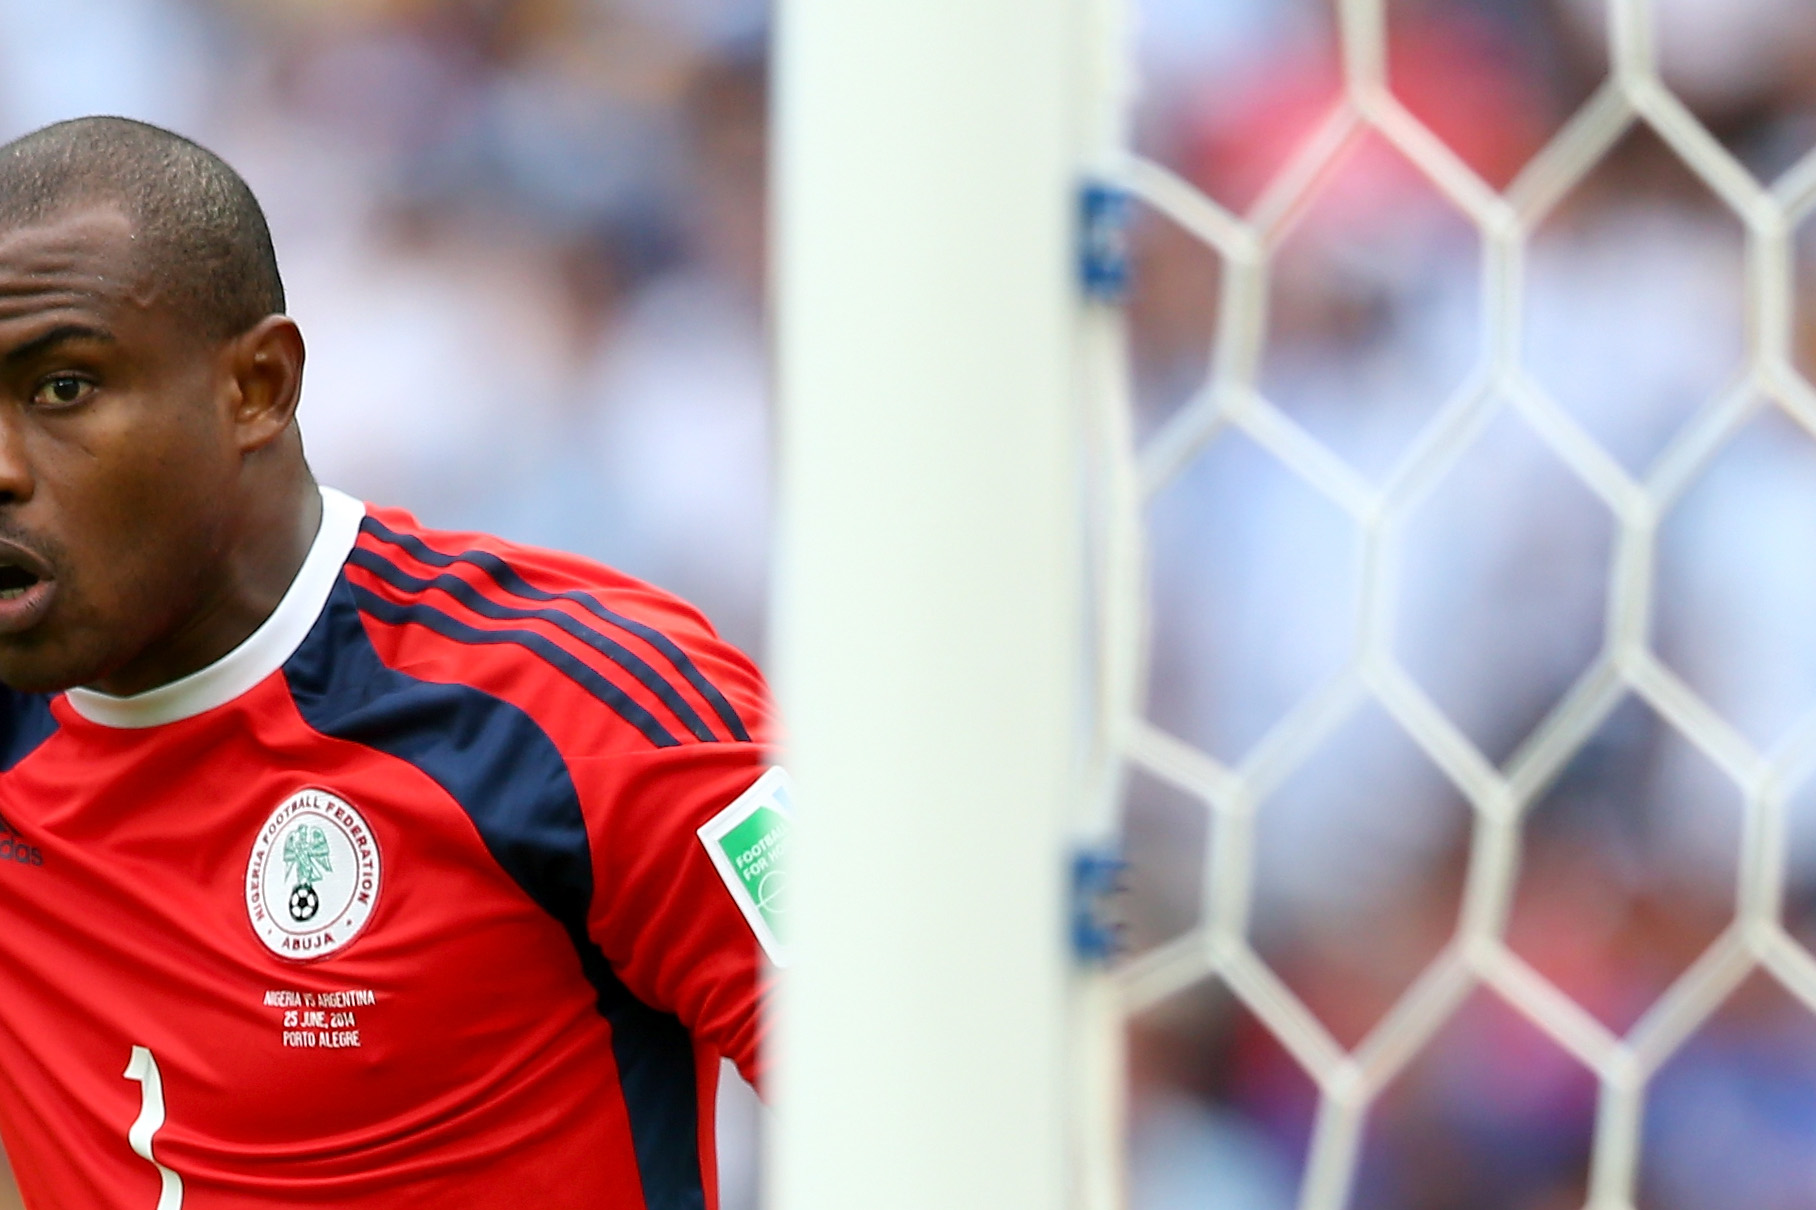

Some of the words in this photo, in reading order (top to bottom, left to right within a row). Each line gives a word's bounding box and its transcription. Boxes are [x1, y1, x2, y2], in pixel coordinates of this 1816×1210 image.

[251, 850, 265, 921] NIGERIA
[263, 796, 320, 845] FOOTBALL
[325, 801, 374, 905] FEDERATION
[743, 857, 769, 881] FOR
[282, 932, 335, 950] ABUJA
[263, 990, 302, 1007] NIGERIA
[317, 990, 375, 1008] ARGENTINA
[284, 1010, 298, 1028] 25
[300, 1010, 329, 1029] JUNE,
[330, 1011, 355, 1028] 2014
[283, 1030, 316, 1047] PORTO
[319, 1030, 361, 1048] ALEGRE
